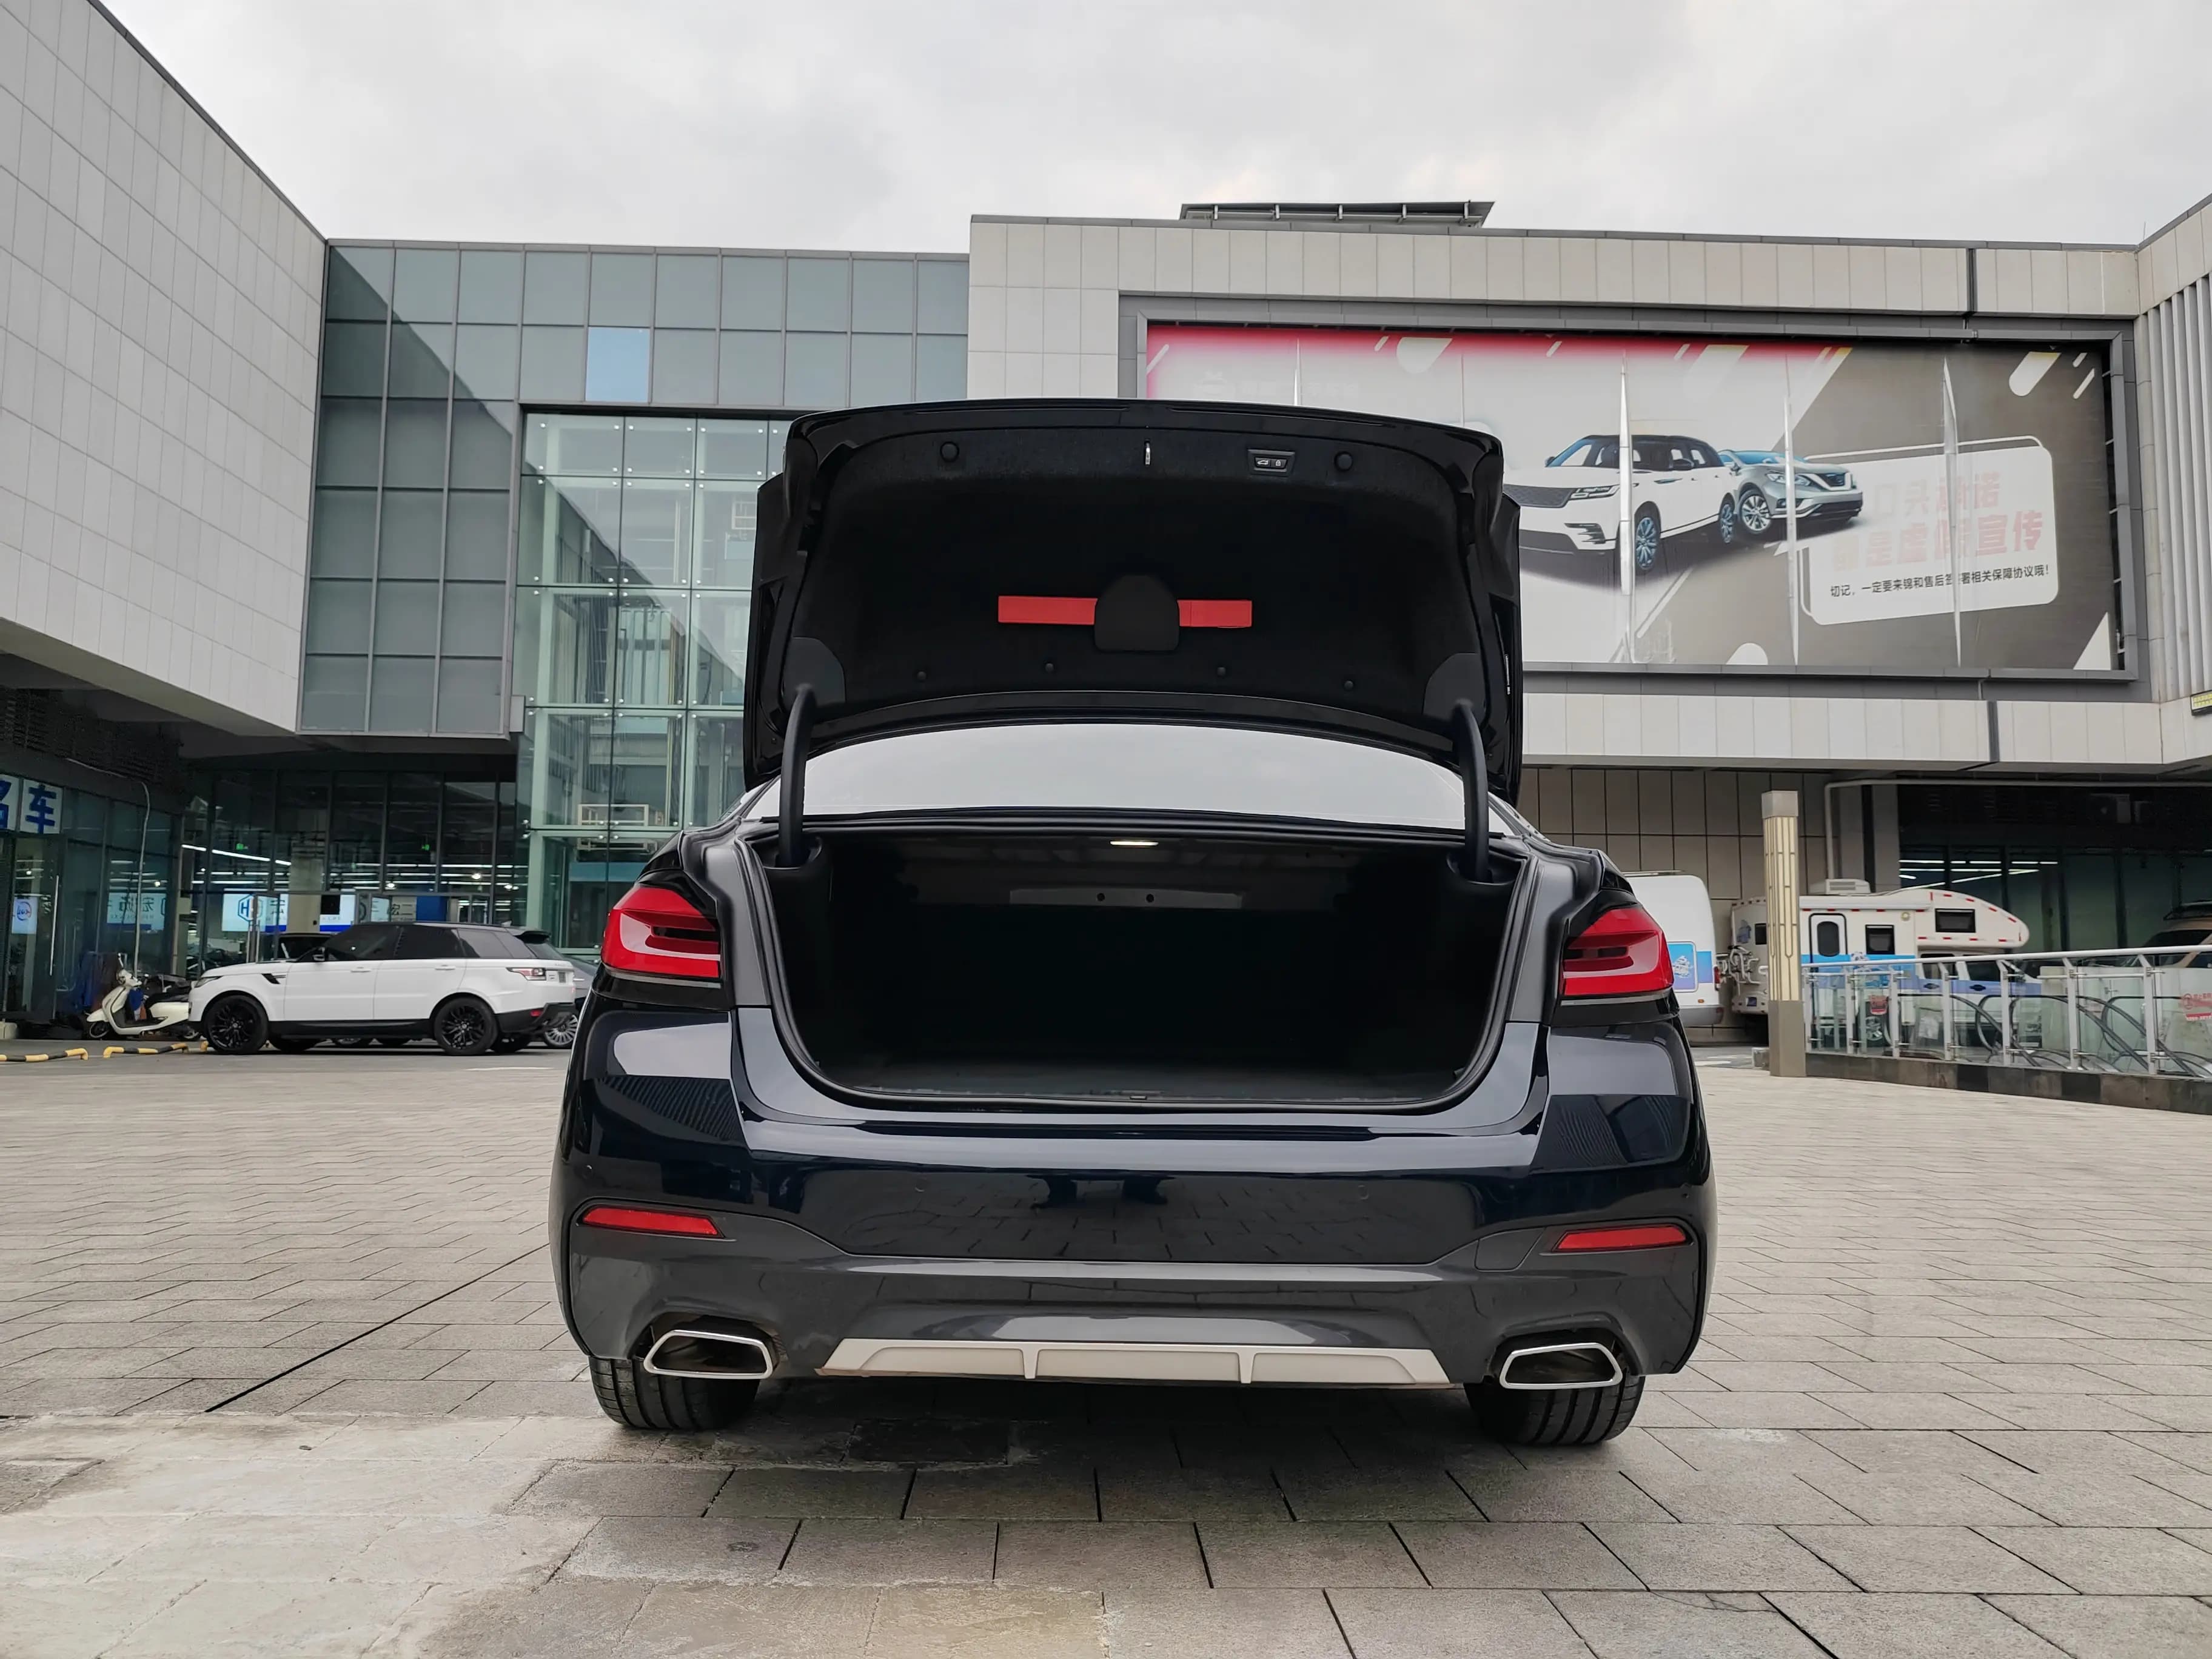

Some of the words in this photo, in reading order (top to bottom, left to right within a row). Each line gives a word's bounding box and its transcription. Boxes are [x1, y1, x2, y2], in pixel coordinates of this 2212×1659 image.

[1833, 510, 2043, 571] 是虚假宣传
